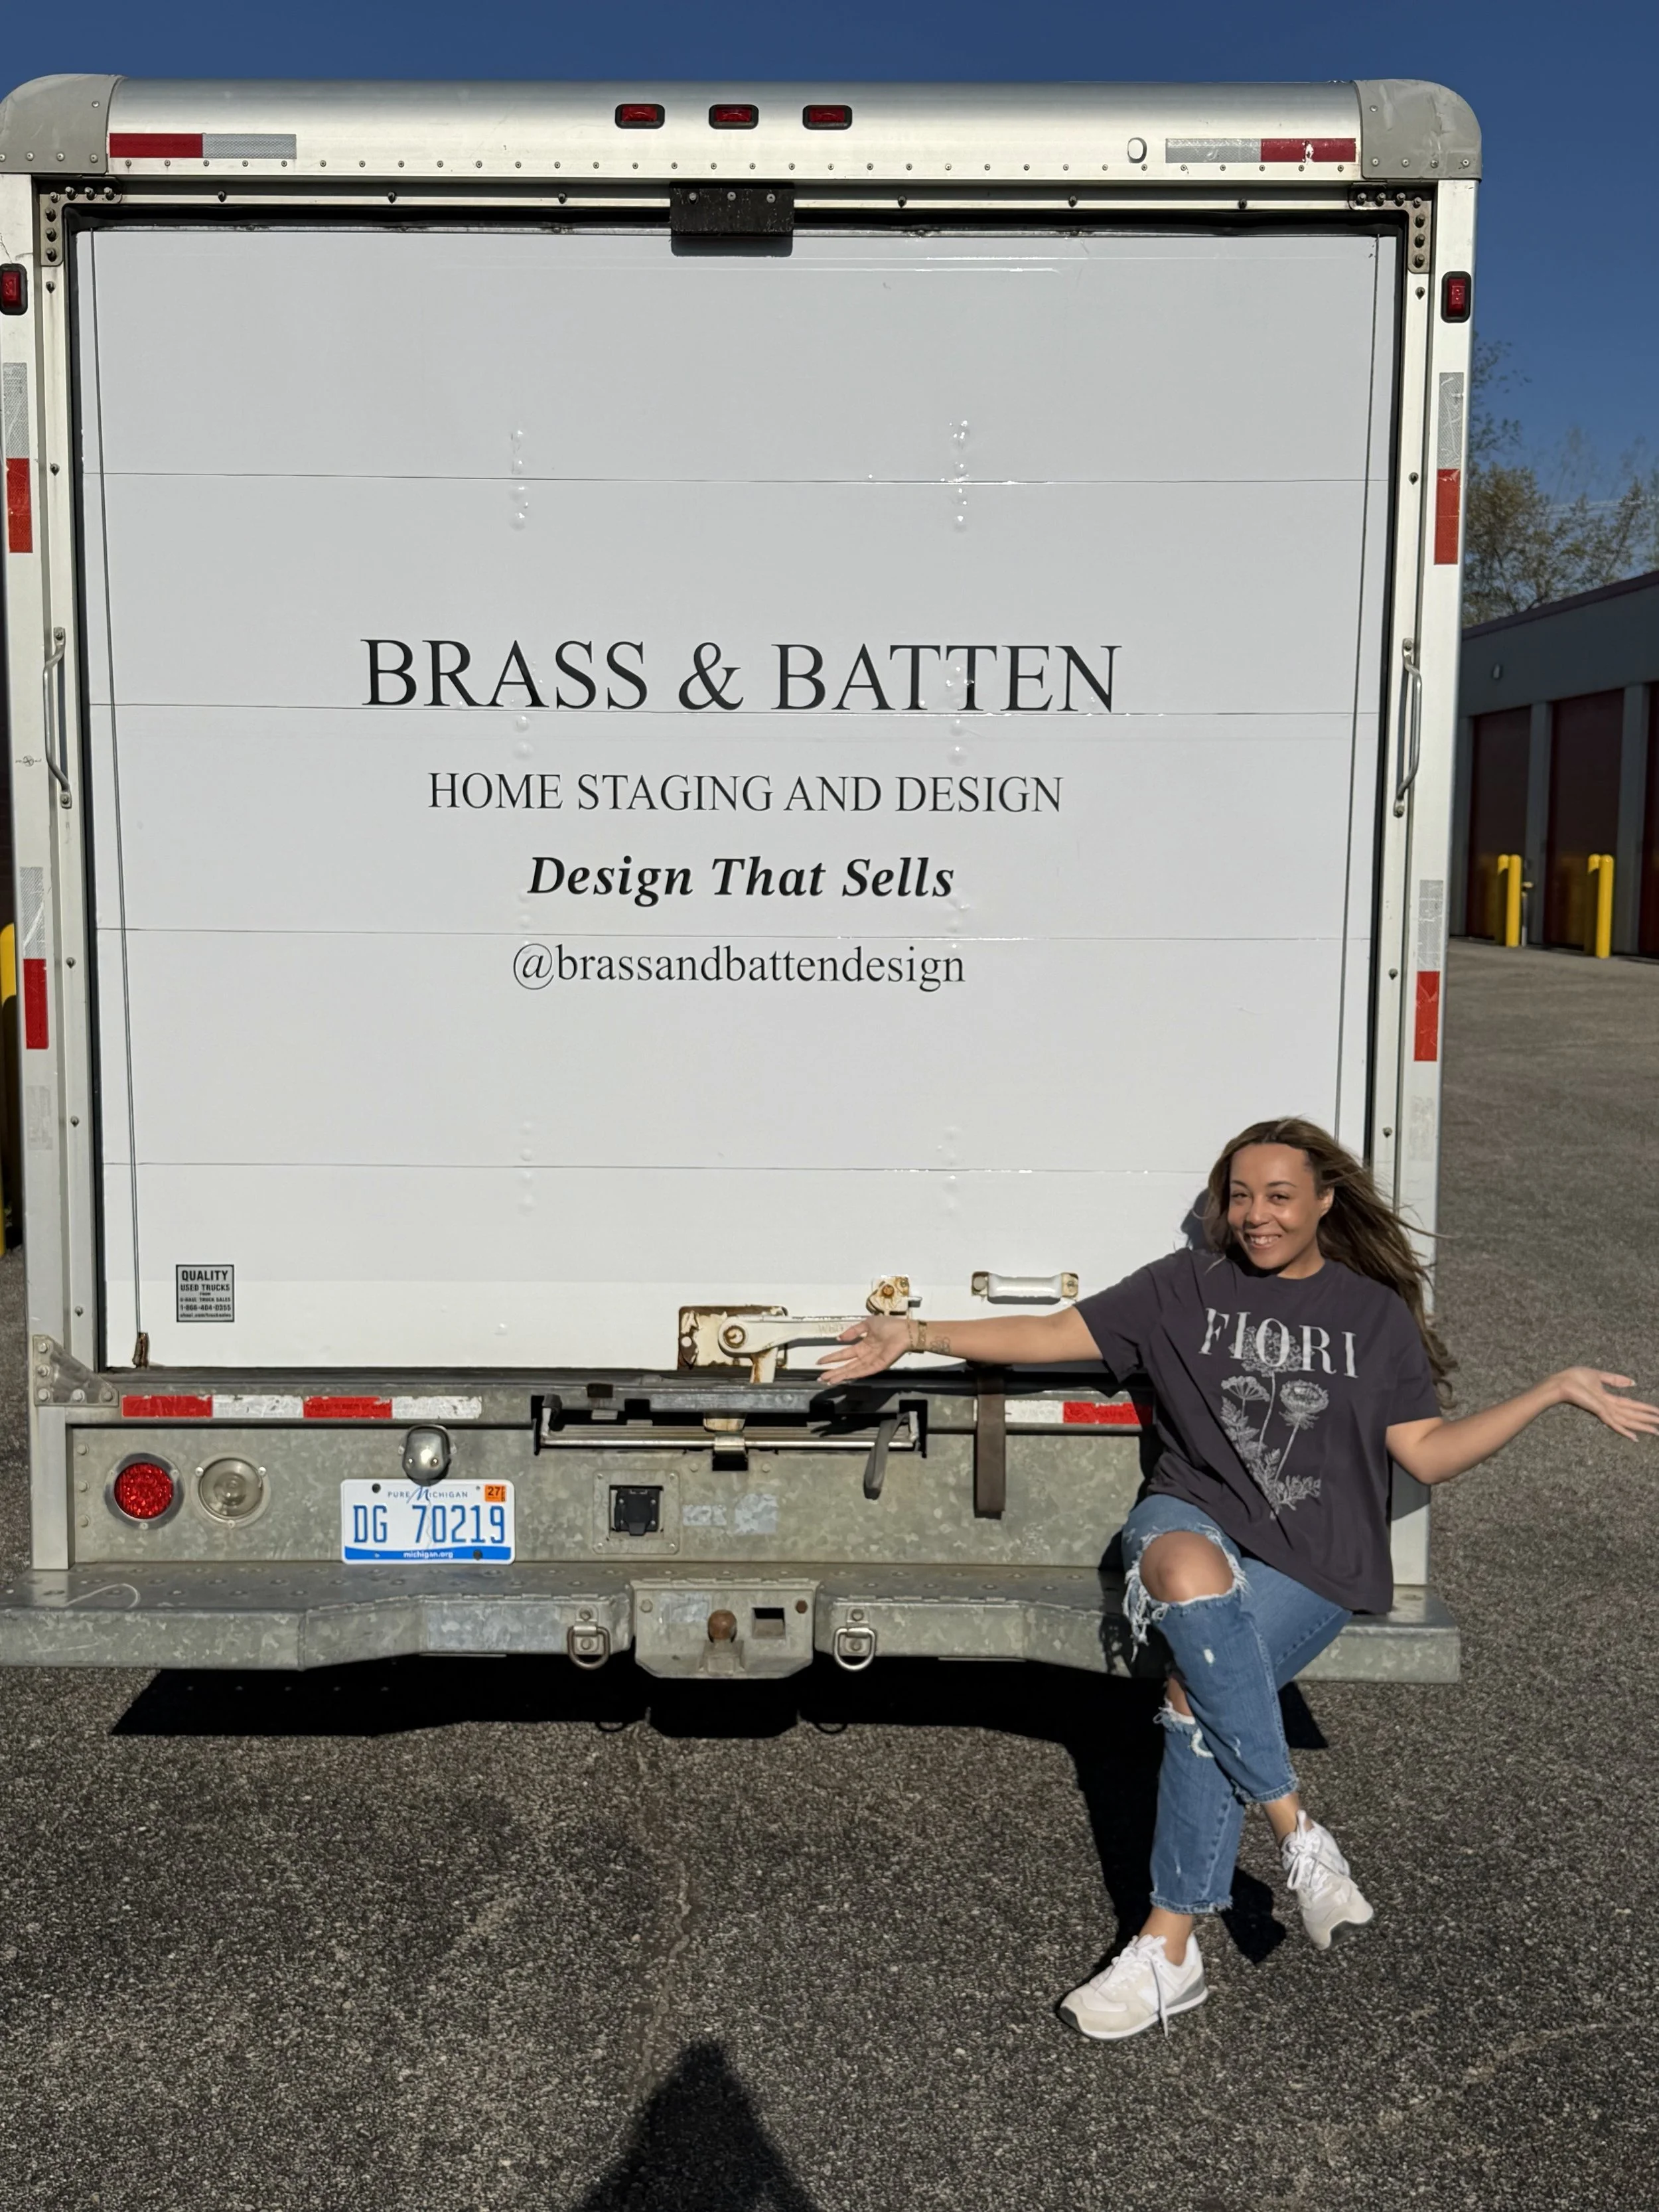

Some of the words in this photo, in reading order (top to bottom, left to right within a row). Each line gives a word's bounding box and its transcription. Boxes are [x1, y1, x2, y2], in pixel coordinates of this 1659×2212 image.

[360, 639, 648, 709] BRASS
[678, 642, 744, 710] &
[771, 644, 1122, 712] BATTEN
[428, 773, 564, 809] HOME
[577, 774, 772, 811] STAGING
[783, 776, 882, 811] AND
[895, 776, 1063, 812] DESIGN
[527, 855, 694, 907] Design
[711, 855, 826, 897] That
[841, 857, 955, 897] Sells
[513, 943, 966, 992] @brassandbattendesign
[181, 1270, 228, 1282] QUALITY
[1198, 1307, 1359, 1378] FIORI
[488, 1485, 501, 1497] 27
[353, 1505, 388, 1544] DG
[411, 1505, 505, 1544] 70219
[403, 1550, 454, 1560] michigan.org
